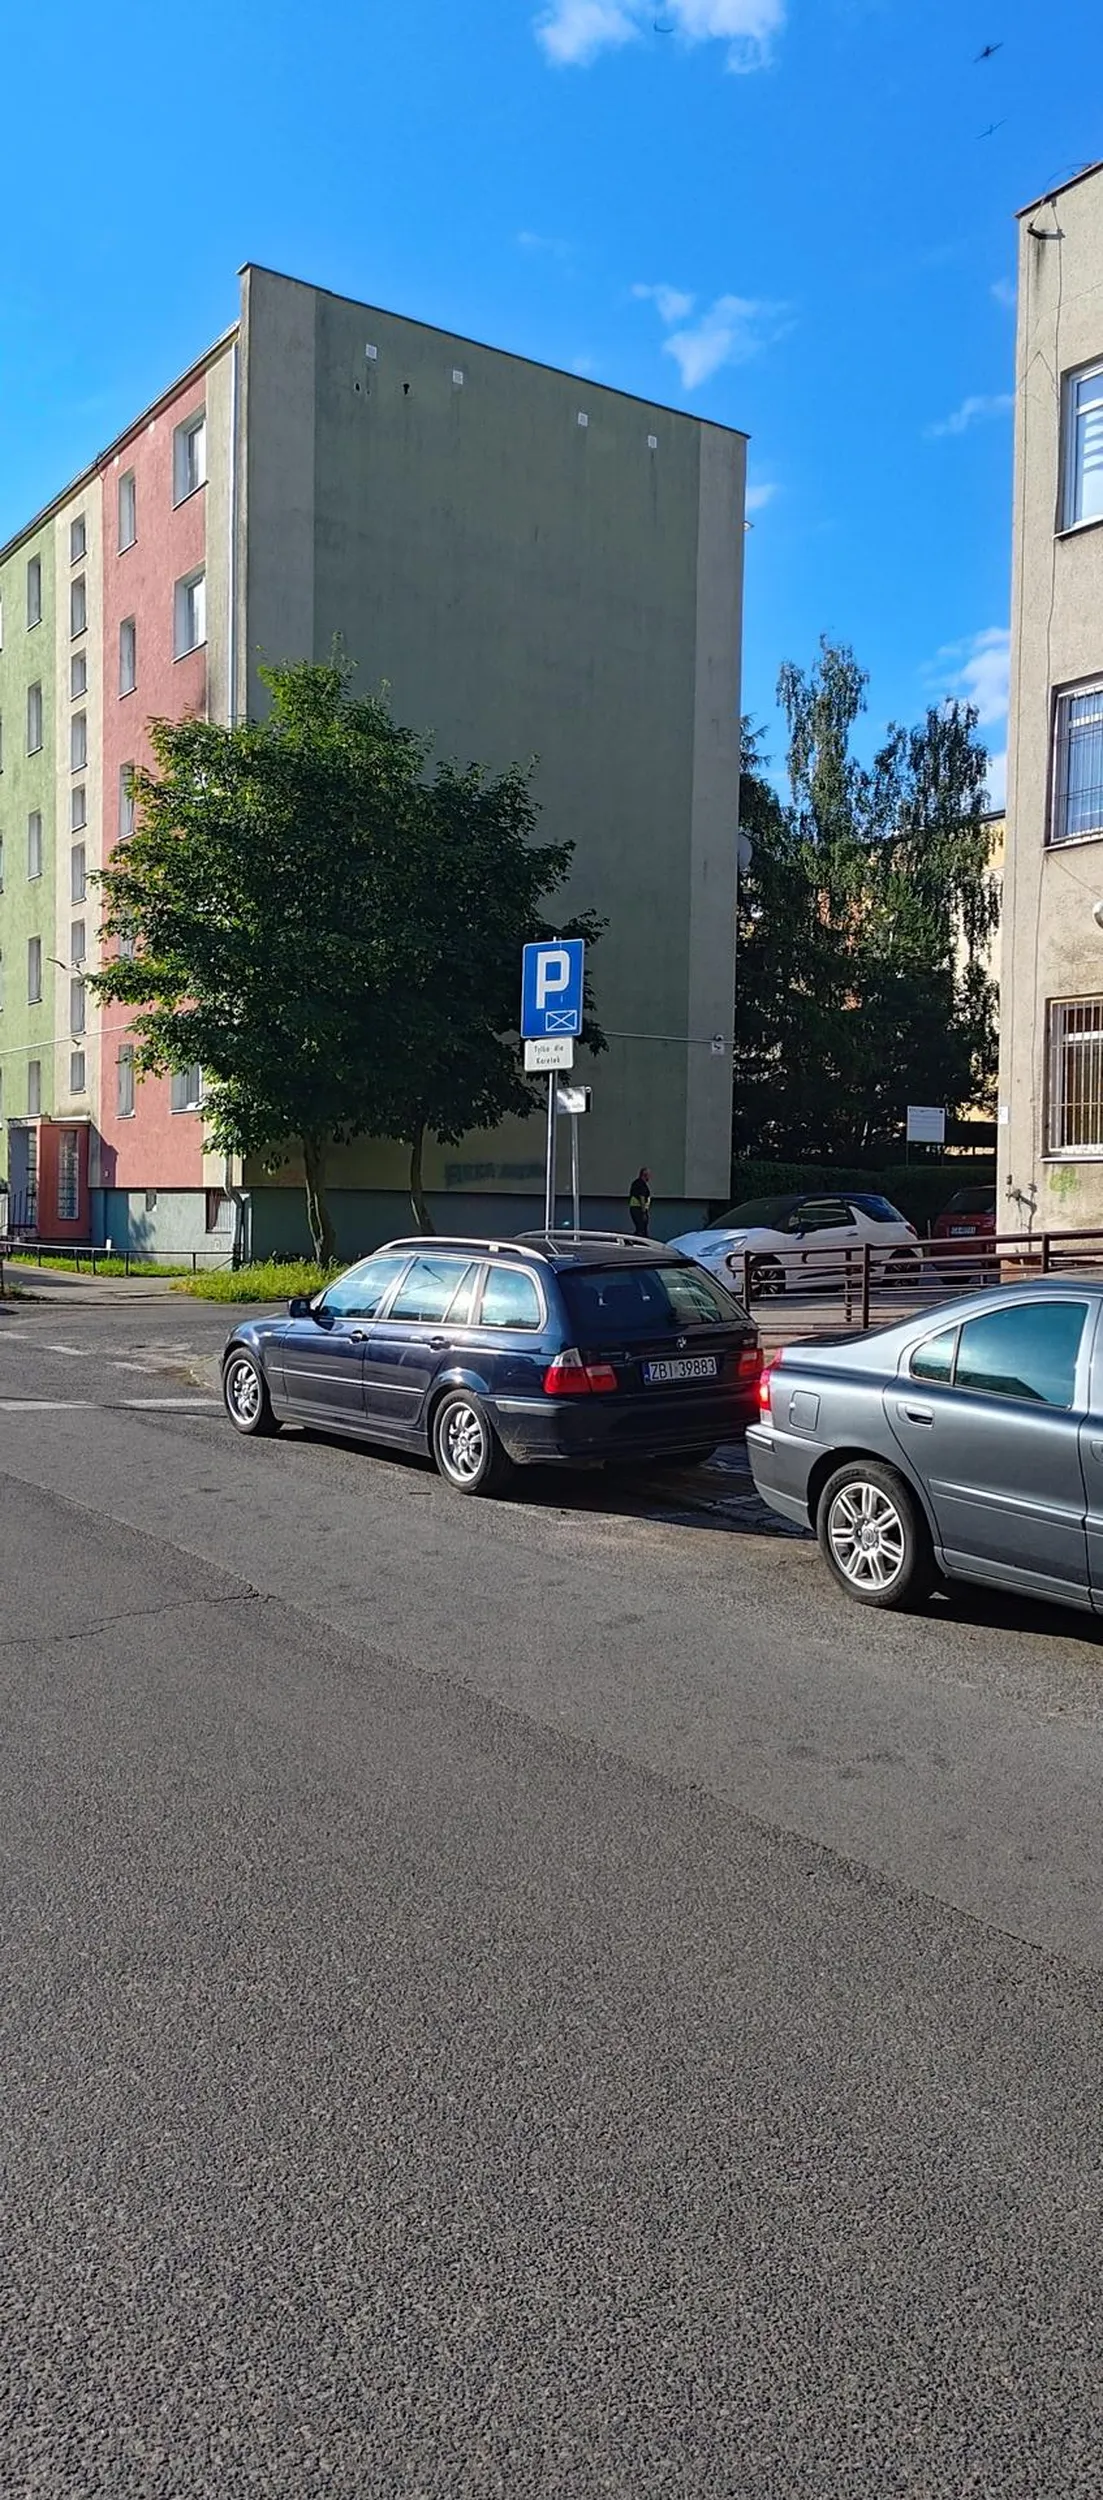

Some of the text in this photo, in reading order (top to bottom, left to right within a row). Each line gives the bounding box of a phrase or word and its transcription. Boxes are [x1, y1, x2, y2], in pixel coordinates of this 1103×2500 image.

[536, 950, 570, 1009] P
[650, 1359, 716, 1381] ZBI 39883
